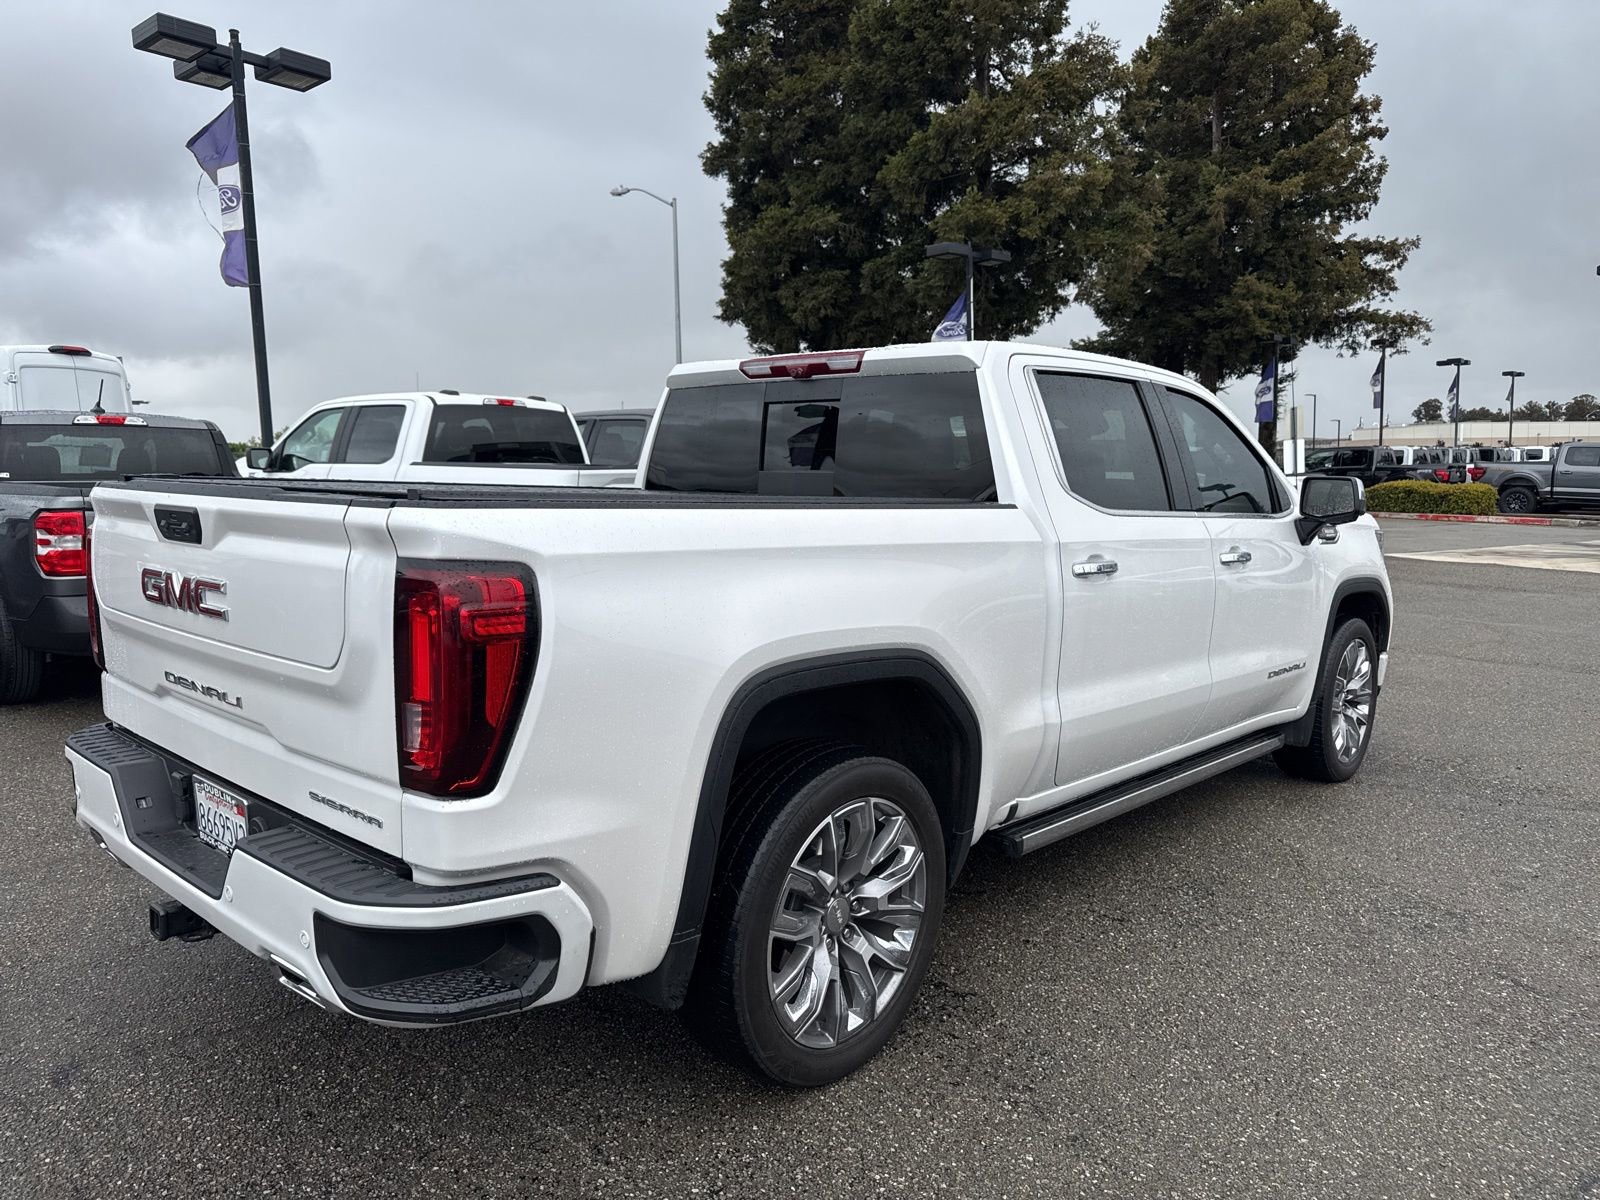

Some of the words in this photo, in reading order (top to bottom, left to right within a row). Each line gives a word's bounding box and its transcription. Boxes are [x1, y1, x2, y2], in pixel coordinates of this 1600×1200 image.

[141, 566, 229, 622] GMC
[1267, 661, 1306, 679] DENALI
[164, 671, 243, 709] DENALI
[308, 791, 383, 829] SIERRA
